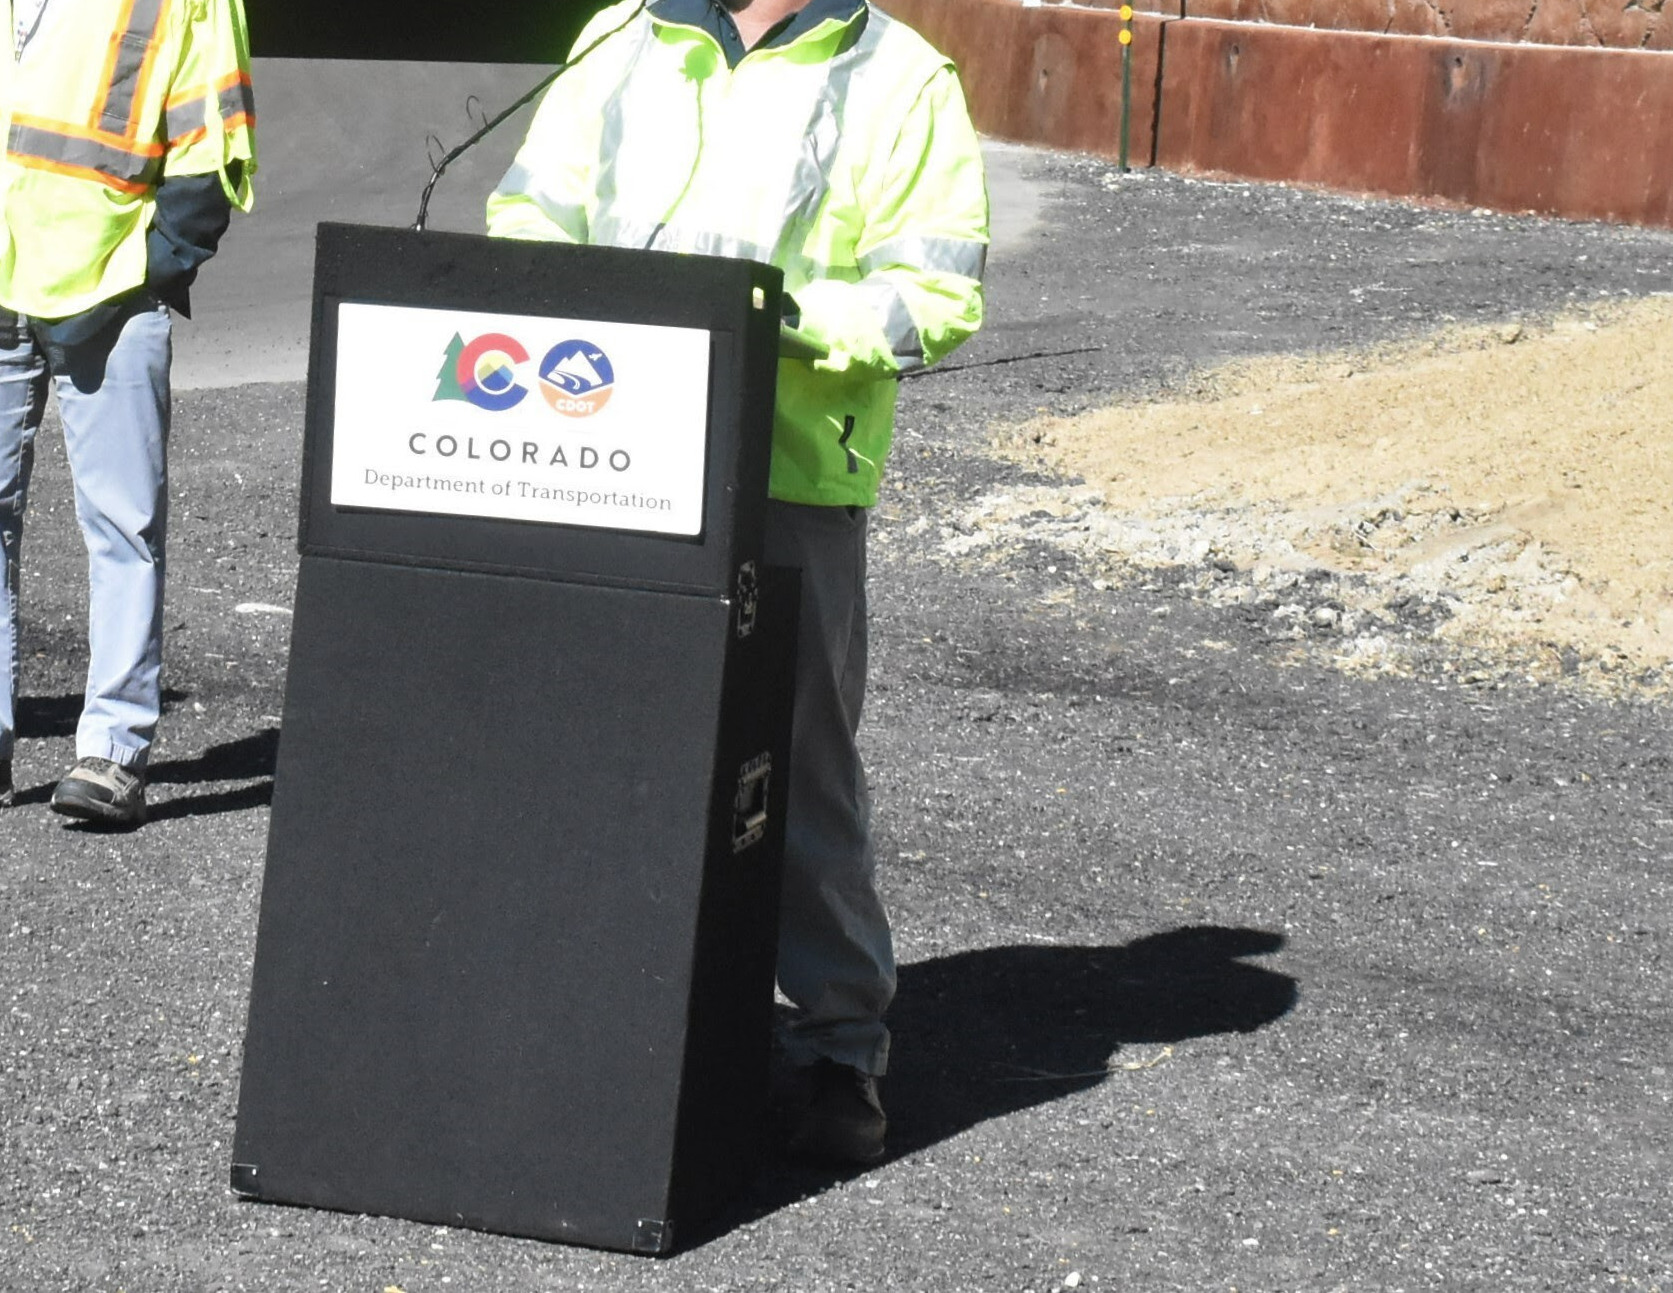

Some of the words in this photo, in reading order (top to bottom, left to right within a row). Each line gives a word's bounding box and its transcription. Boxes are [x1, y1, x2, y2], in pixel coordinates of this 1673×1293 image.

[556, 398, 595, 413] CDOT
[408, 432, 631, 472] COLORADO
[364, 468, 485, 496] Department
[491, 482, 512, 497] of
[517, 480, 672, 511] Transportation
